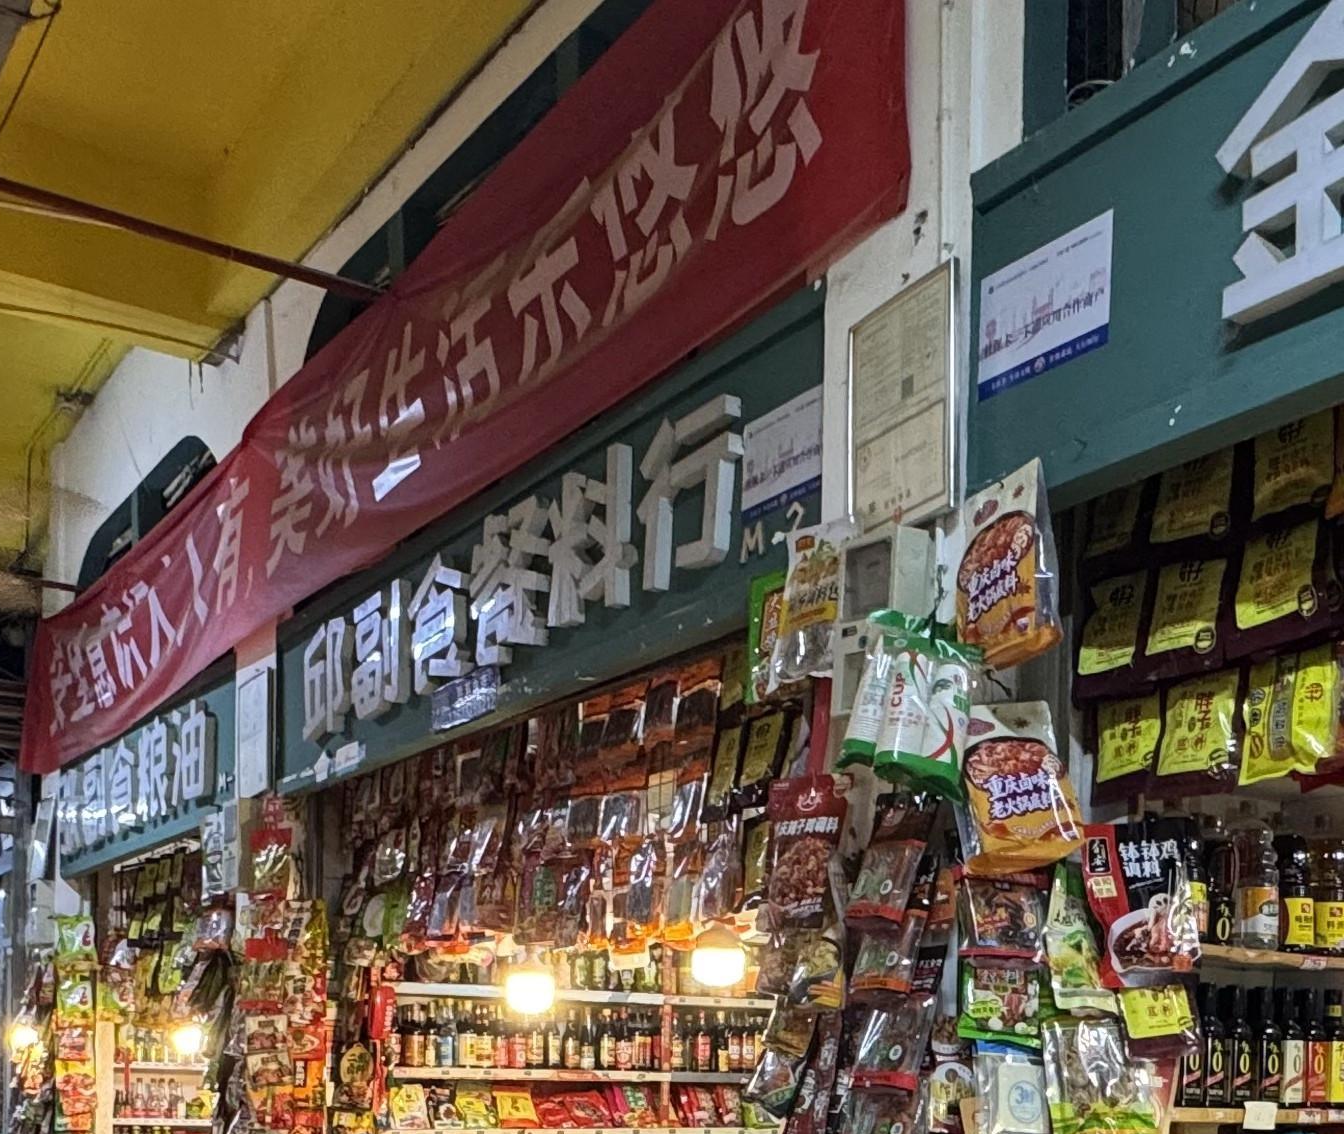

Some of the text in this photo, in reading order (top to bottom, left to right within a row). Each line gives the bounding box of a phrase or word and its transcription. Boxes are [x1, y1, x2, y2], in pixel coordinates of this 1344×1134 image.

[886, 665, 899, 696] CUP
[984, 771, 1050, 799] 重庆卤味
